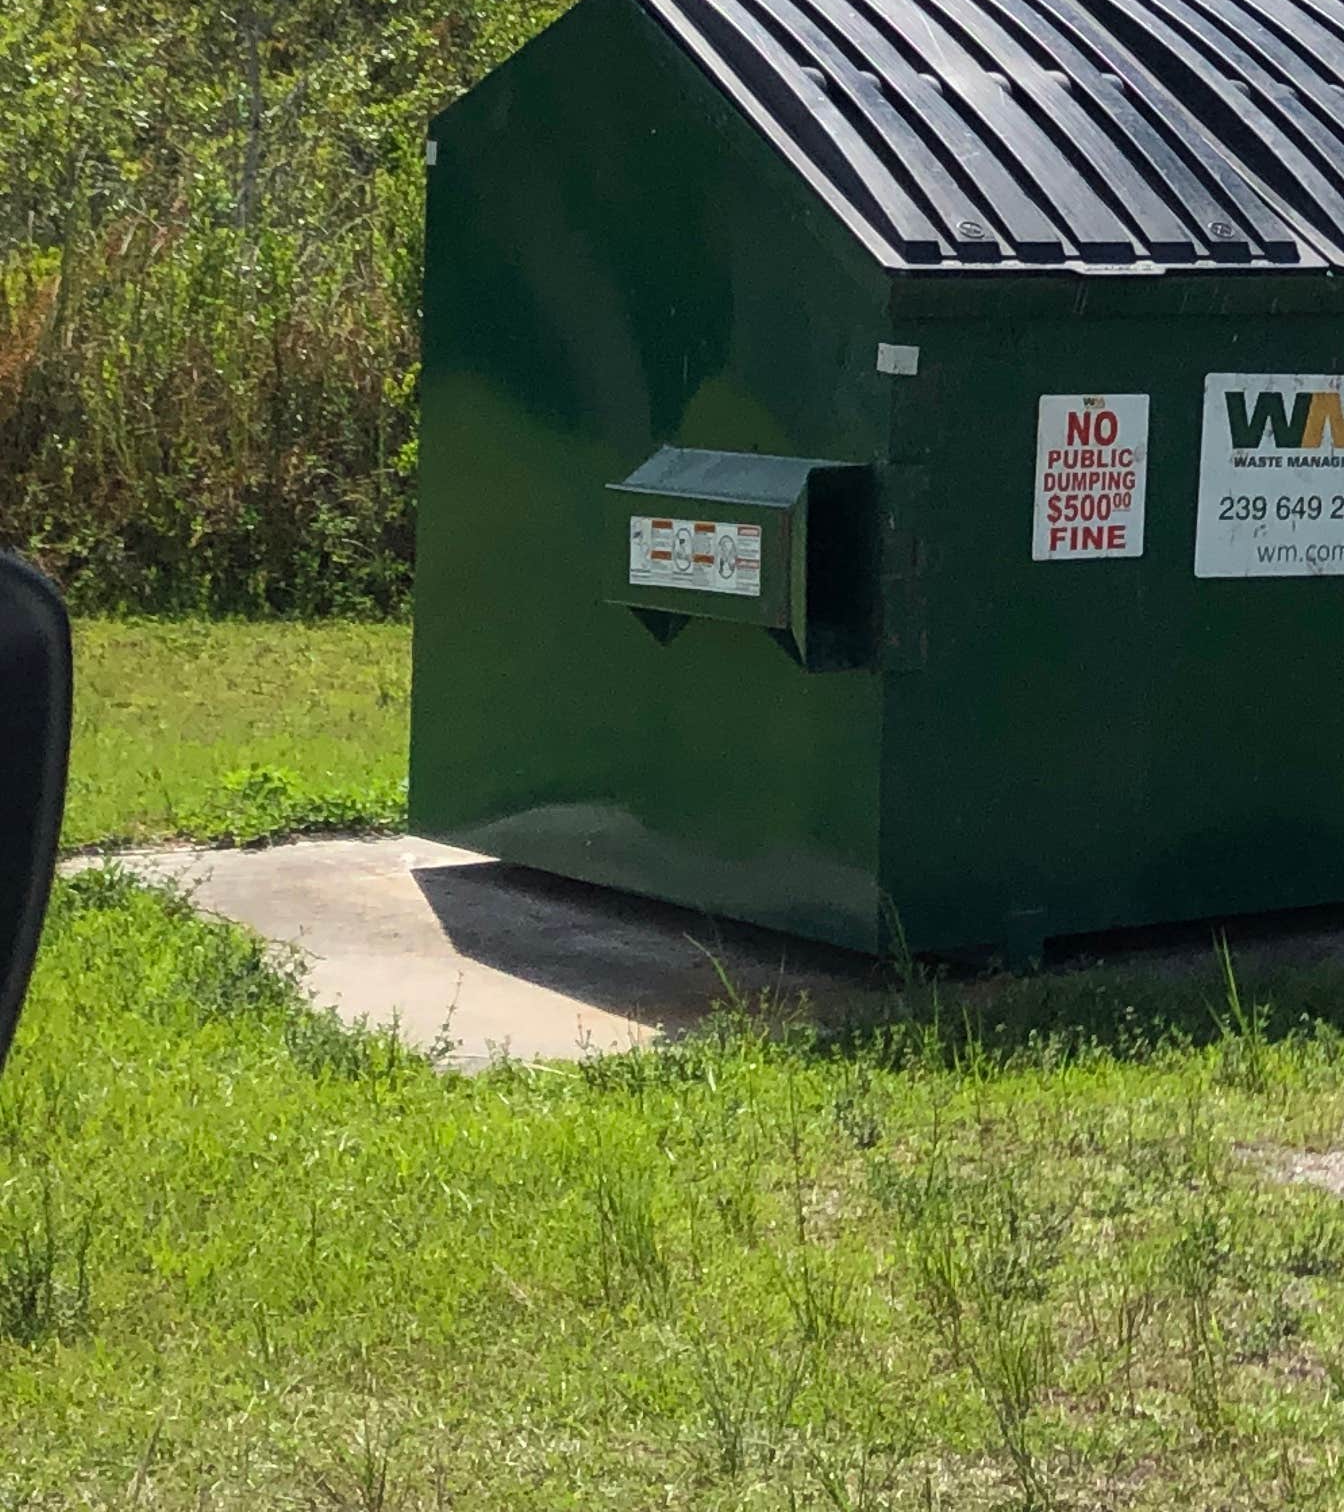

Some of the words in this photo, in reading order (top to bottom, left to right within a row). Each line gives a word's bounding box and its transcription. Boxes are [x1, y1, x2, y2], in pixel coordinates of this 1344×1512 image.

[1066, 411, 1119, 447] NO
[1047, 448, 1134, 470] PUBLIC
[1233, 456, 1283, 468] WASTE
[1043, 471, 1136, 492] DUMPING
[1218, 496, 1268, 521] 239
[1275, 495, 1323, 520] 649
[1049, 525, 1127, 552] FINE
